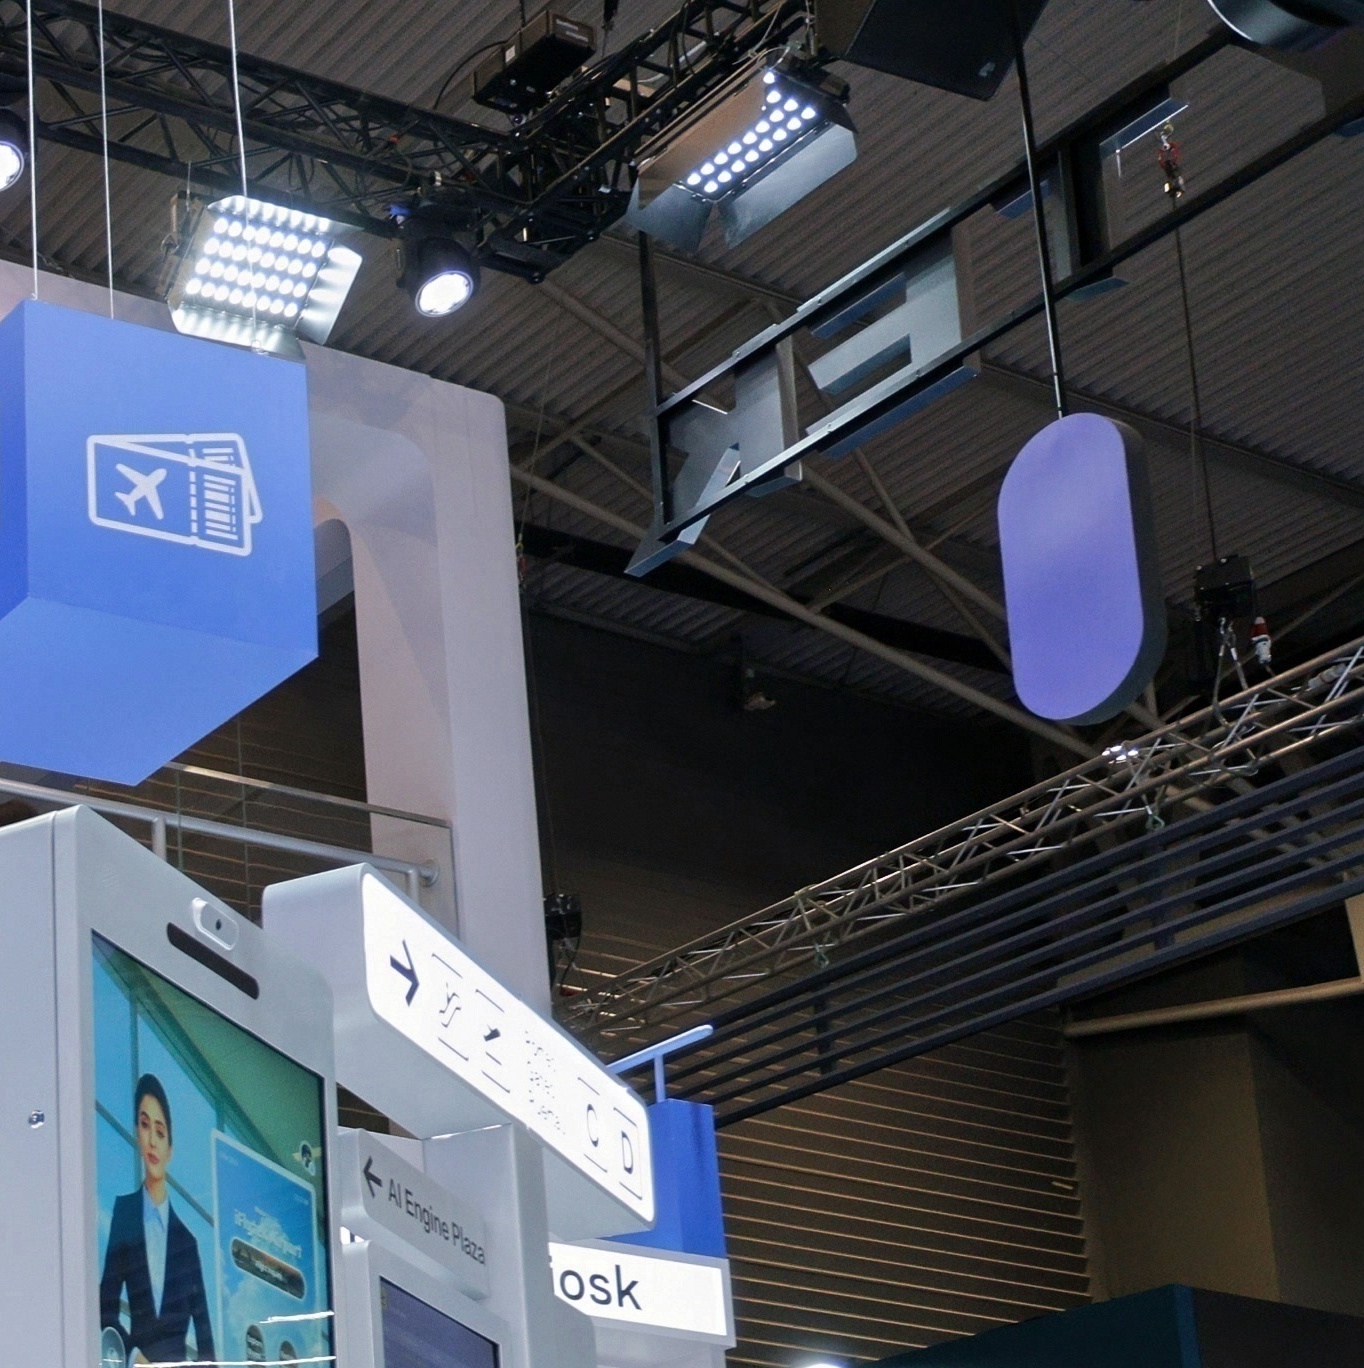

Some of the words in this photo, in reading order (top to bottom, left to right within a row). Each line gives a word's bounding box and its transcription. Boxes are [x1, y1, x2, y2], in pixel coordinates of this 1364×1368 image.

[621, 1131, 634, 1175] D
[388, 1178, 402, 1208] AI
[405, 1188, 450, 1241] Engine
[451, 1221, 486, 1266] Plaza
